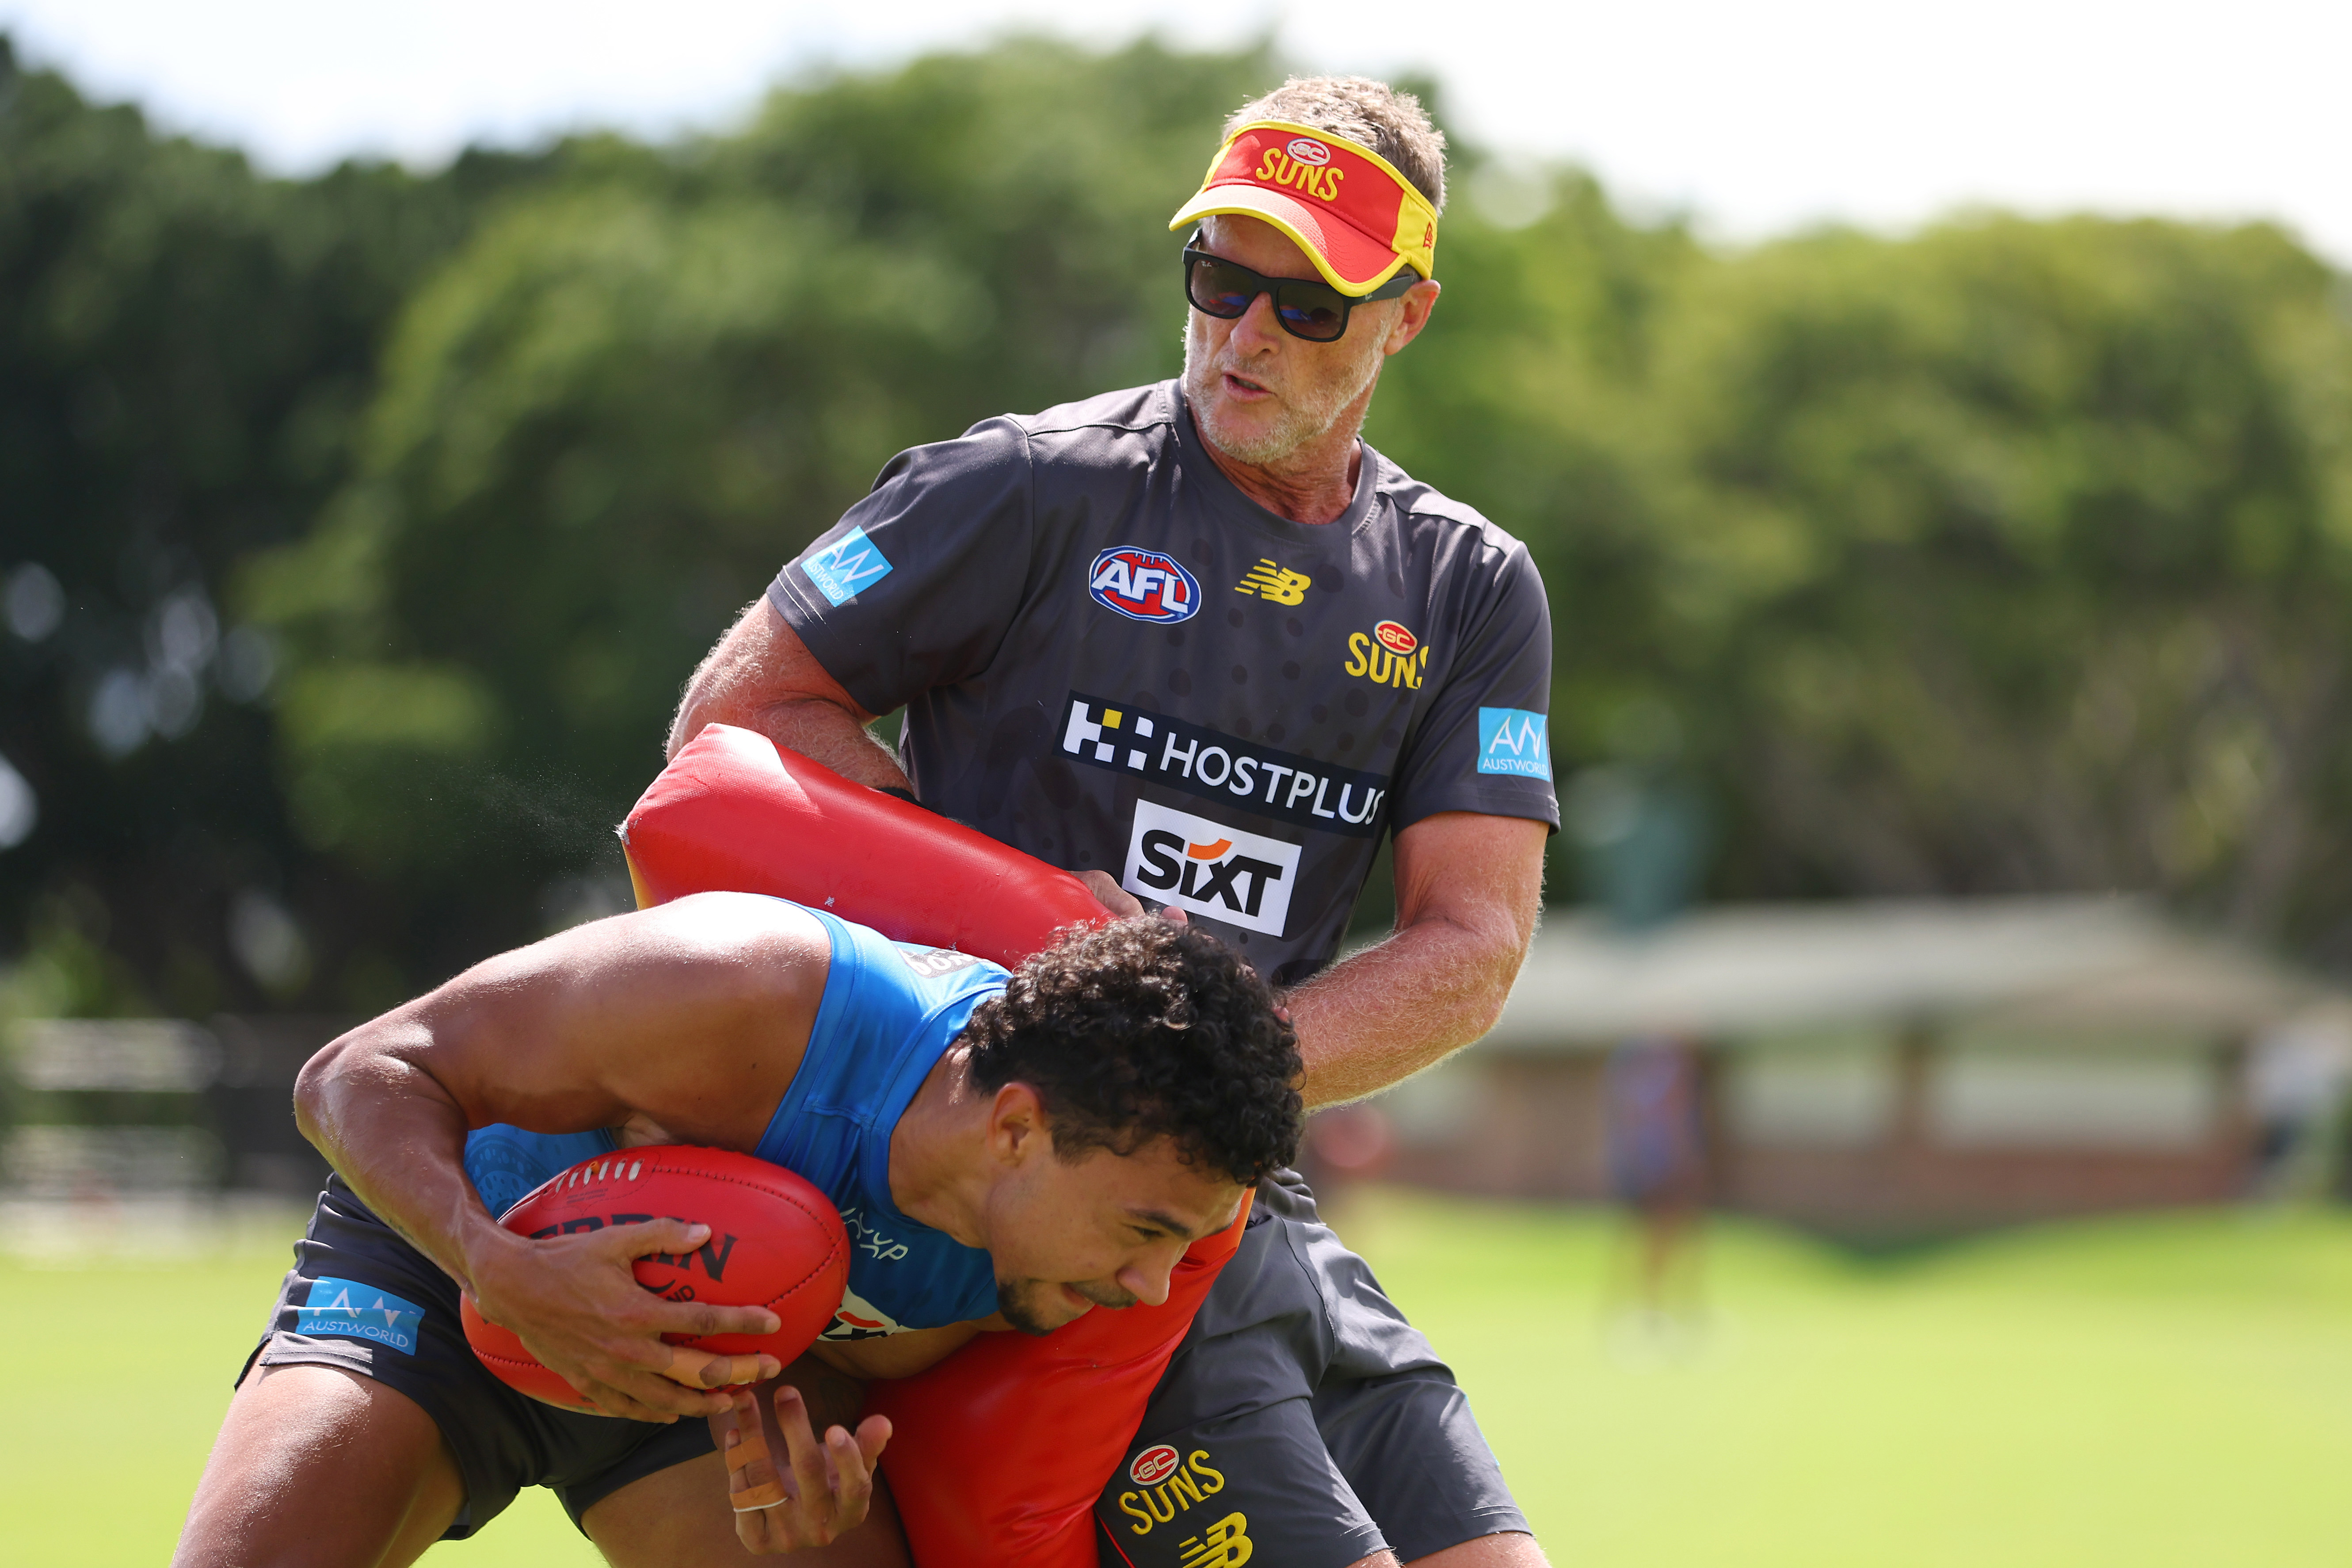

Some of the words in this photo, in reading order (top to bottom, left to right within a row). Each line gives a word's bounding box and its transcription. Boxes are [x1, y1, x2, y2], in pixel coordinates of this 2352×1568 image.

[1256, 148, 1344, 201] SUNS
[1091, 558, 1189, 614] AFL
[1483, 758, 1548, 776] AUSTWORLD
[303, 1321, 409, 1347] AUSTWORLD
[1118, 1450, 1225, 1535] SUNS
